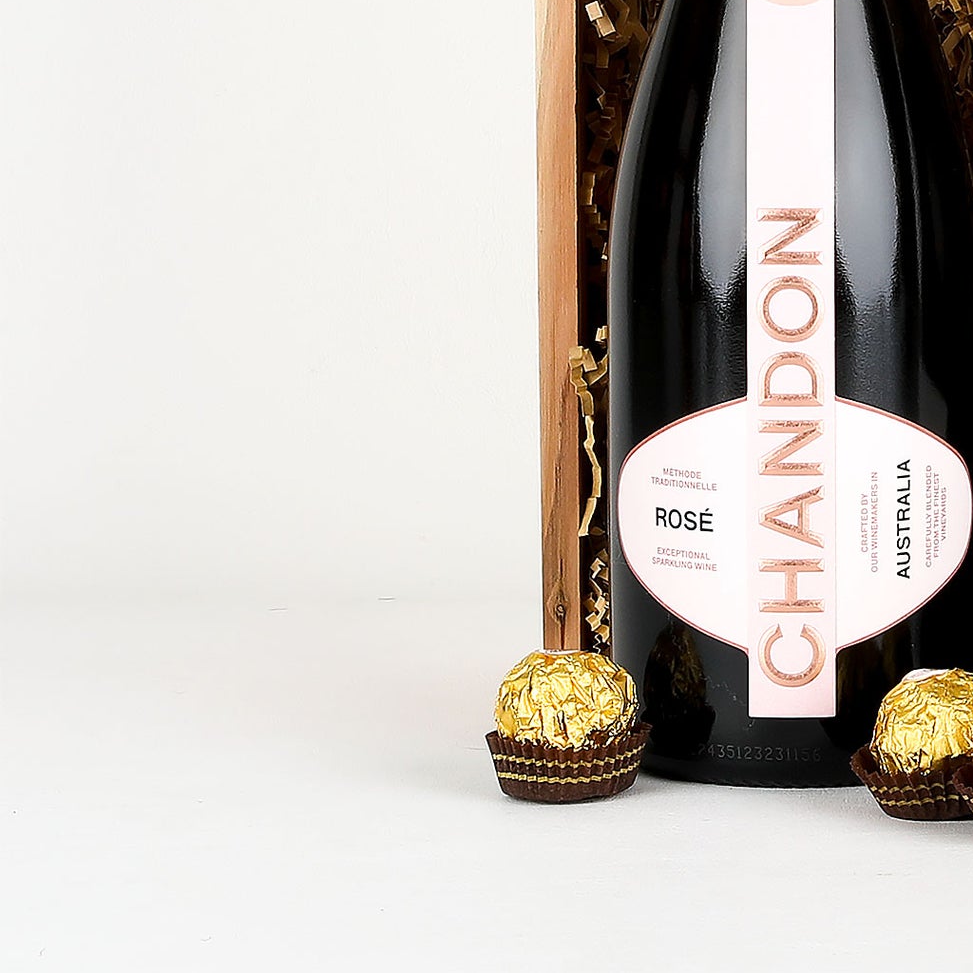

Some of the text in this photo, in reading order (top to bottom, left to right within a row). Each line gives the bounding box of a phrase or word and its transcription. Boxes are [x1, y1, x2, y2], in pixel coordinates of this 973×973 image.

[757, 208, 826, 687] CHANDON
[871, 471, 878, 482] IN
[655, 506, 714, 532] ROSÉ
[861, 493, 869, 553] CRAFTED BY
[897, 459, 911, 579] AUSTRALIA
[652, 556, 718, 572] SPARKLING WINE
[657, 546, 711, 561] EXCEPTIONAL
